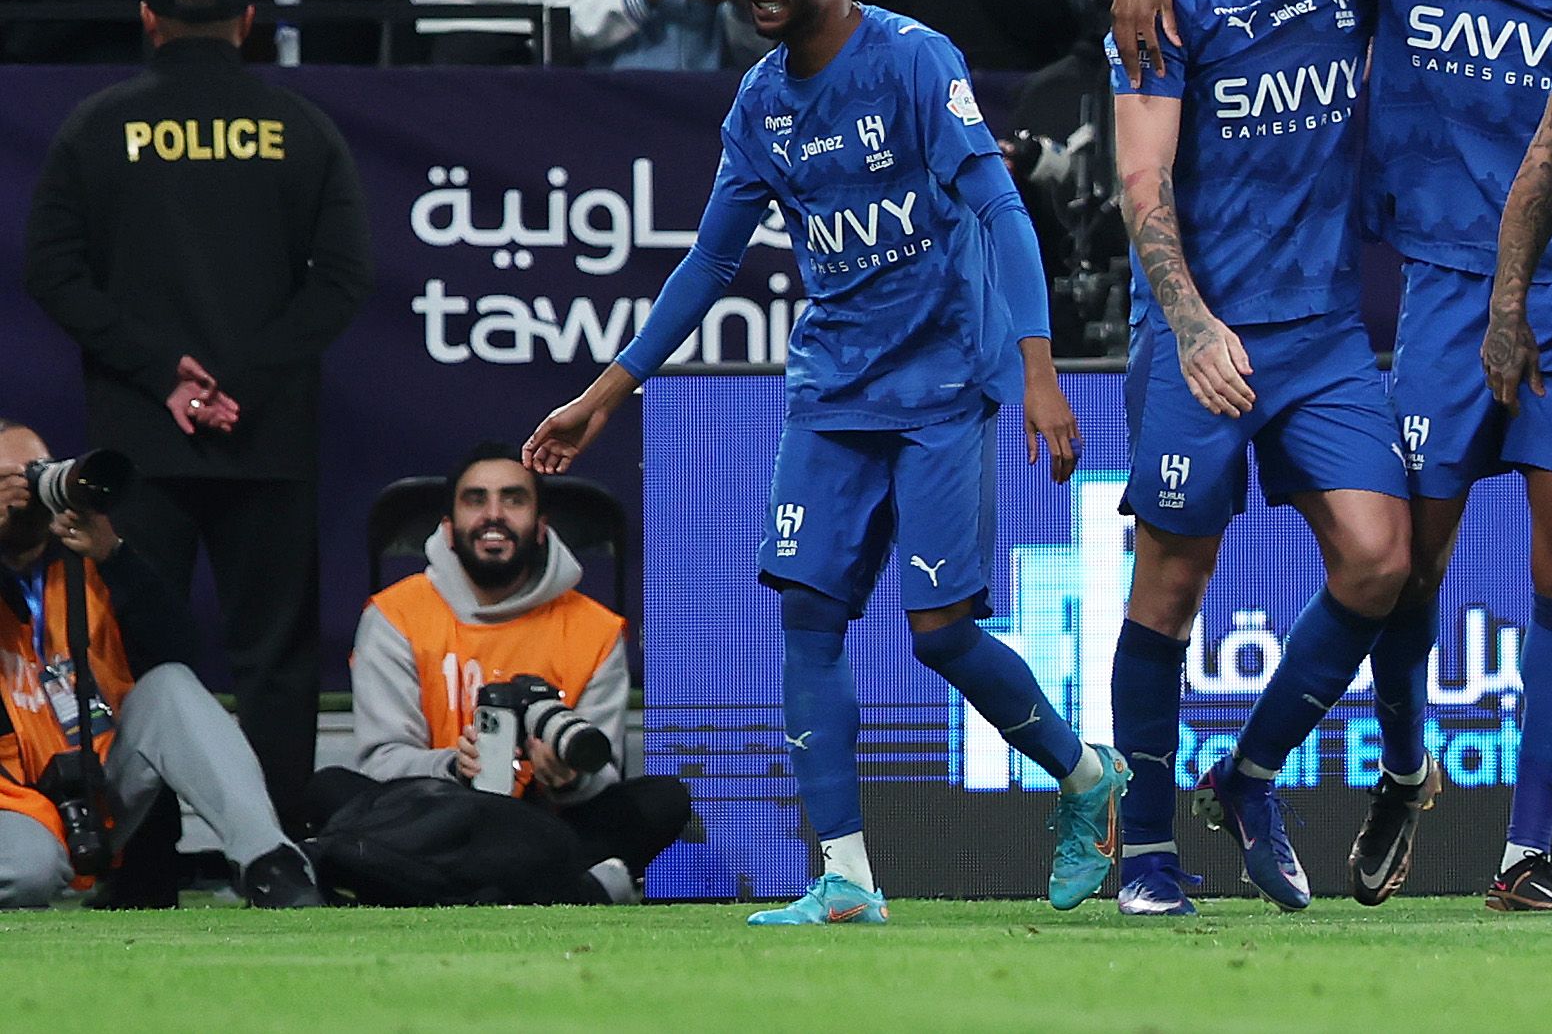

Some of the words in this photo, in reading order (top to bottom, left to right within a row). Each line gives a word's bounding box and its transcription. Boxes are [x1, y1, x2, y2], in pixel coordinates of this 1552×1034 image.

[1411, 55, 1493, 81] GAMES
[1214, 57, 1358, 119] SAVVY
[125, 119, 285, 162] POLICE
[1221, 120, 1298, 139] GAMES
[857, 239, 932, 269] GROUP
